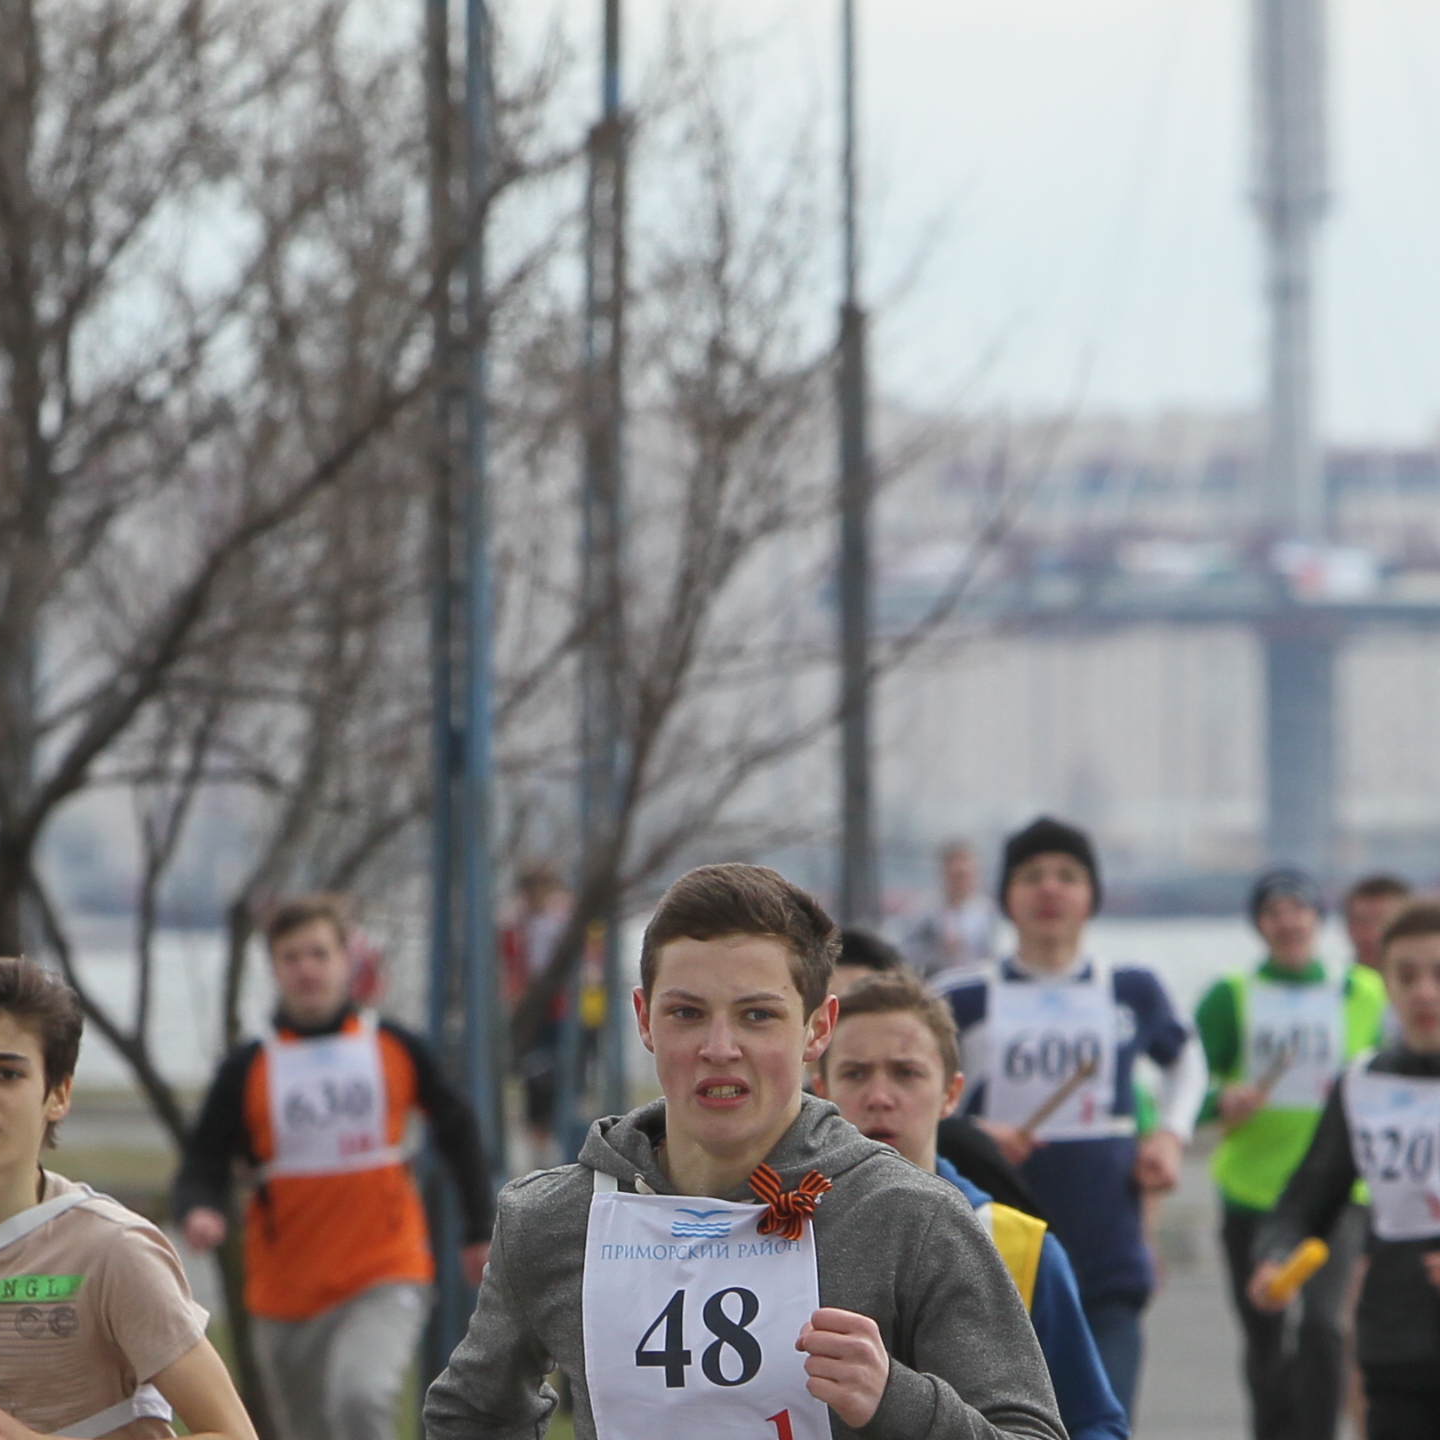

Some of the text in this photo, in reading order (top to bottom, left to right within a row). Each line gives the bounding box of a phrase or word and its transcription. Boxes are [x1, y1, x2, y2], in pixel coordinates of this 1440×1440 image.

[1003, 1028, 1103, 1083] 600
[600, 1239, 801, 1260] ПРИМОРСКИЙ РАЙОН
[634, 1286, 762, 1388] 48
